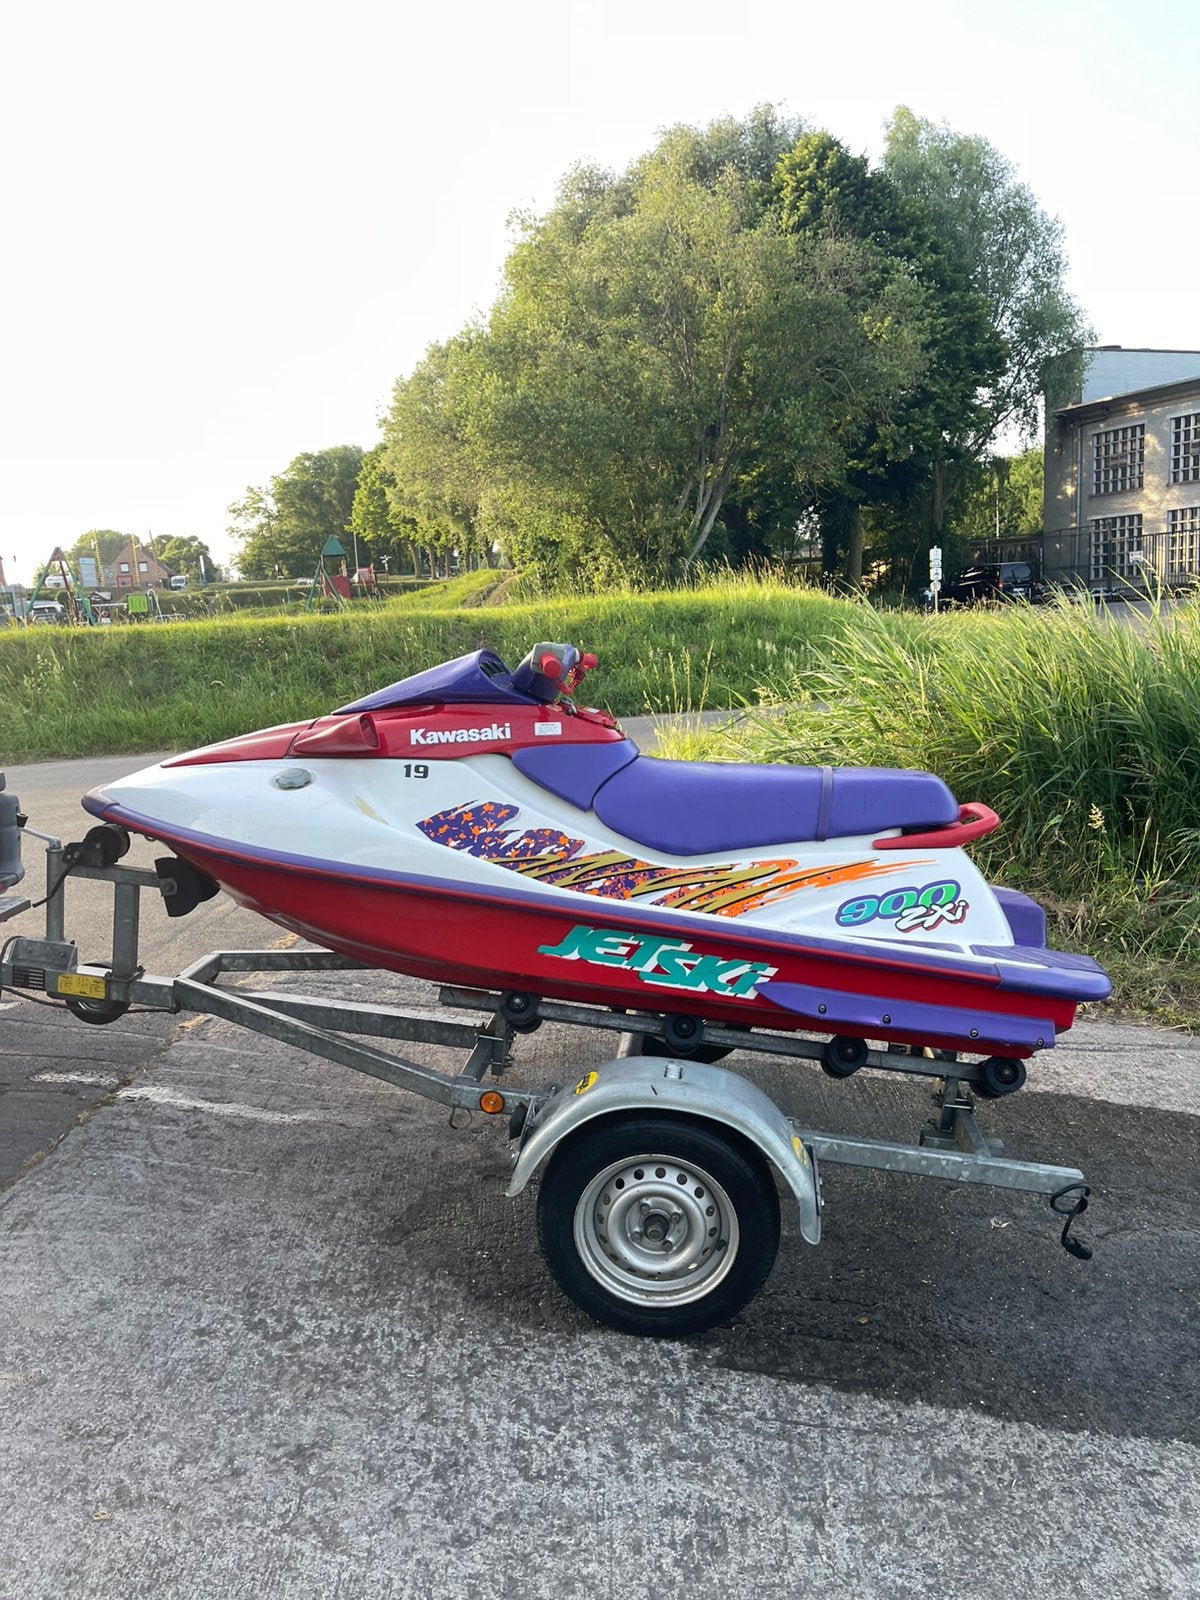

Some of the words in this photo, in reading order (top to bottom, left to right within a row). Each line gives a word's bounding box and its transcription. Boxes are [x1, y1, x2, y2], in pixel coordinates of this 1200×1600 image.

[410, 723, 511, 745] Kawasaki
[404, 764, 429, 779] 19
[836, 880, 961, 927] 900
